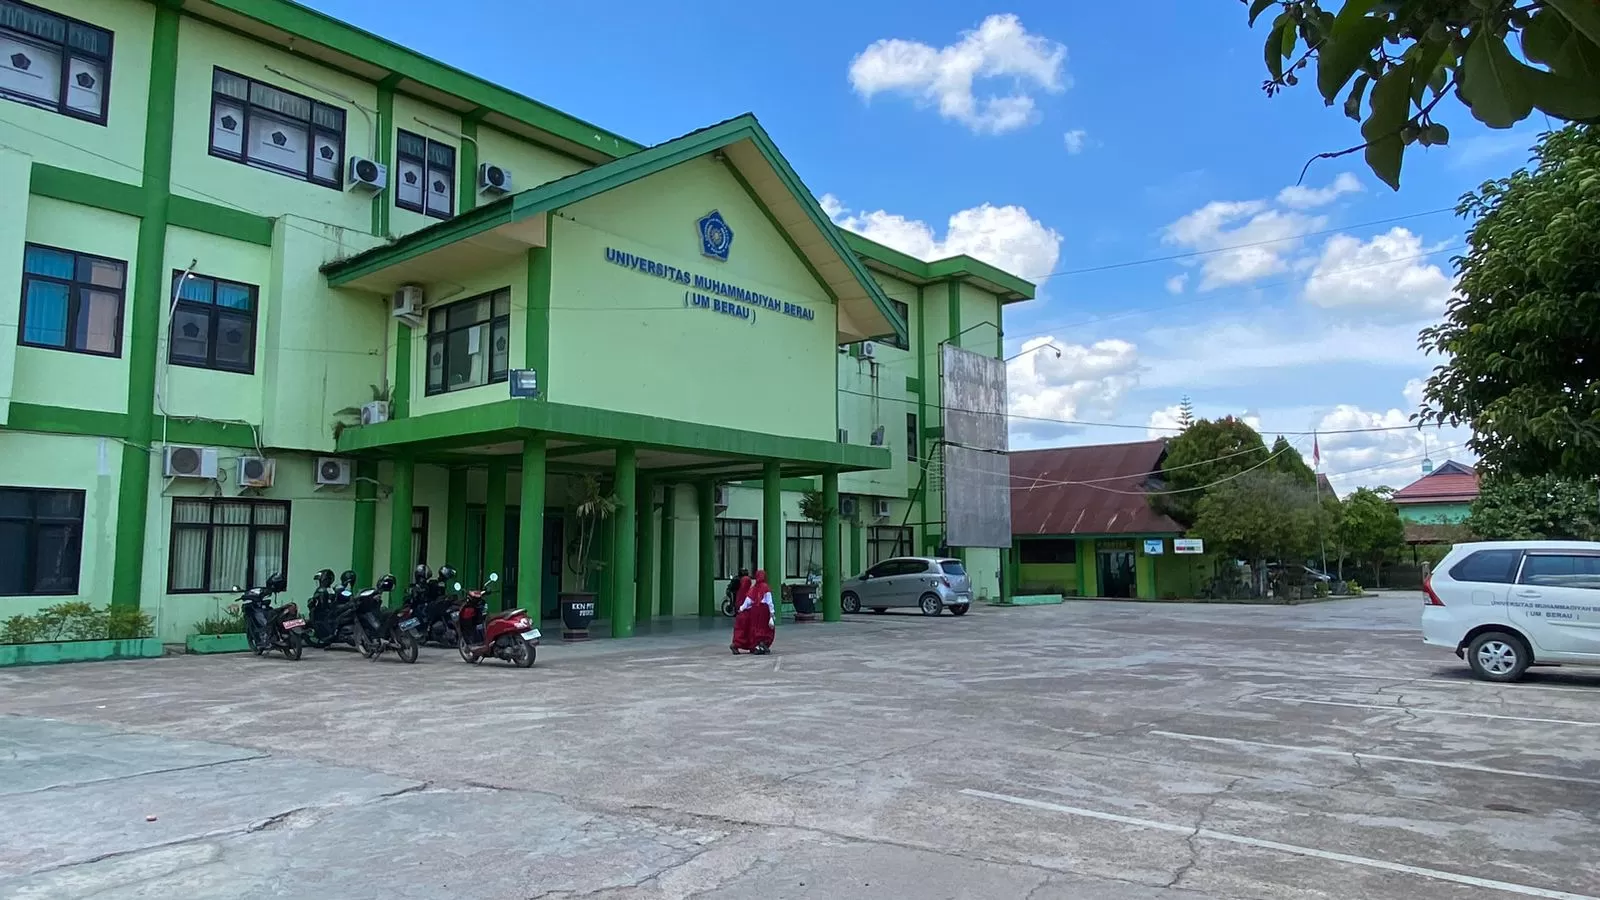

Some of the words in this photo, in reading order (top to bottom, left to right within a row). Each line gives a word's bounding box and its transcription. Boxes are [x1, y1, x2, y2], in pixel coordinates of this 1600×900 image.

[606, 246, 691, 285] UNIVERSITAS
[694, 274, 782, 313] MUHAMMADIYAH
[783, 302, 815, 321] BERAU
[1491, 600, 1534, 609] UNIVERSITAS
[1535, 603, 1591, 611] MUHAMMADIYAH
